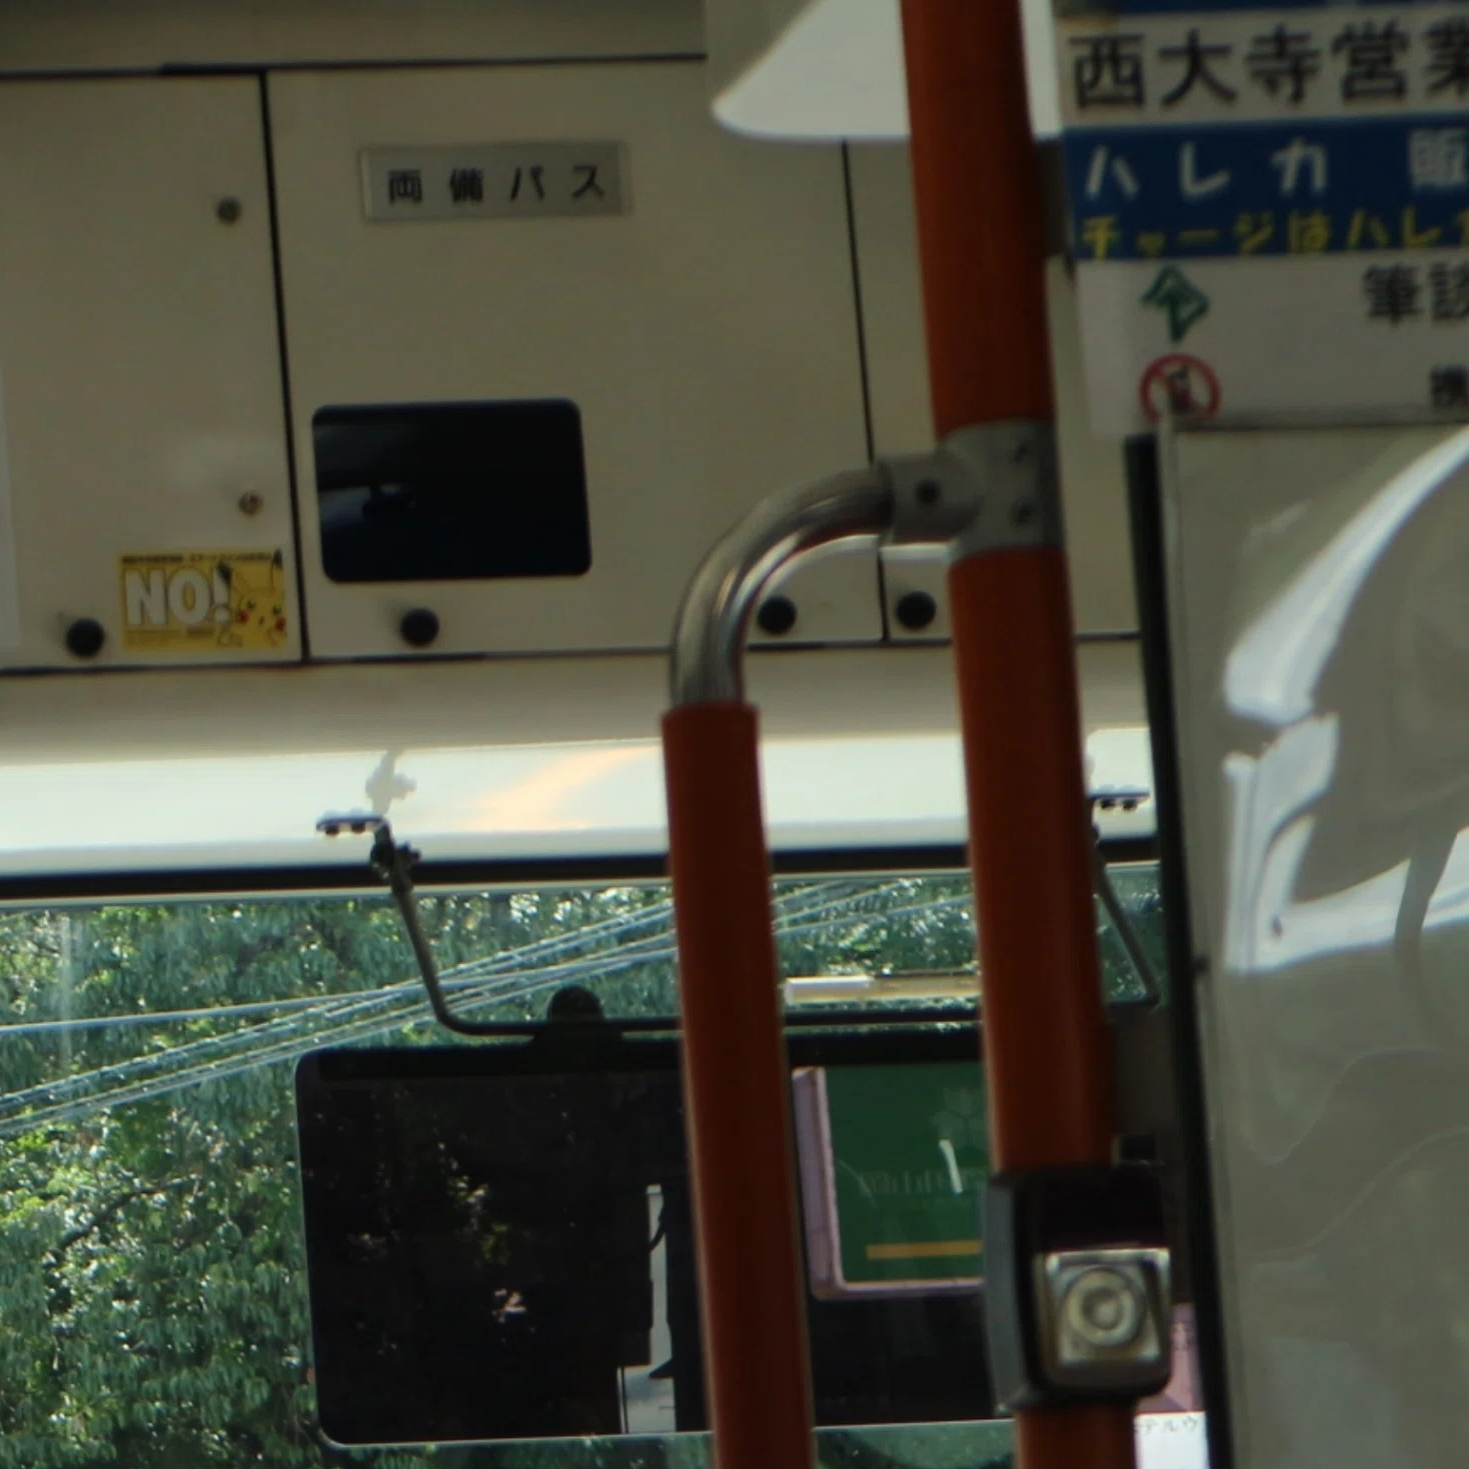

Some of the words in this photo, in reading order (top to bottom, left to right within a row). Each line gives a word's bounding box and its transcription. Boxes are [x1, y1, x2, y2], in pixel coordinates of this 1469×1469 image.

[376, 163, 606, 204] 両備バス
[1083, 203, 1469, 262] チャージはハレ
[124, 567, 231, 628] NO!
